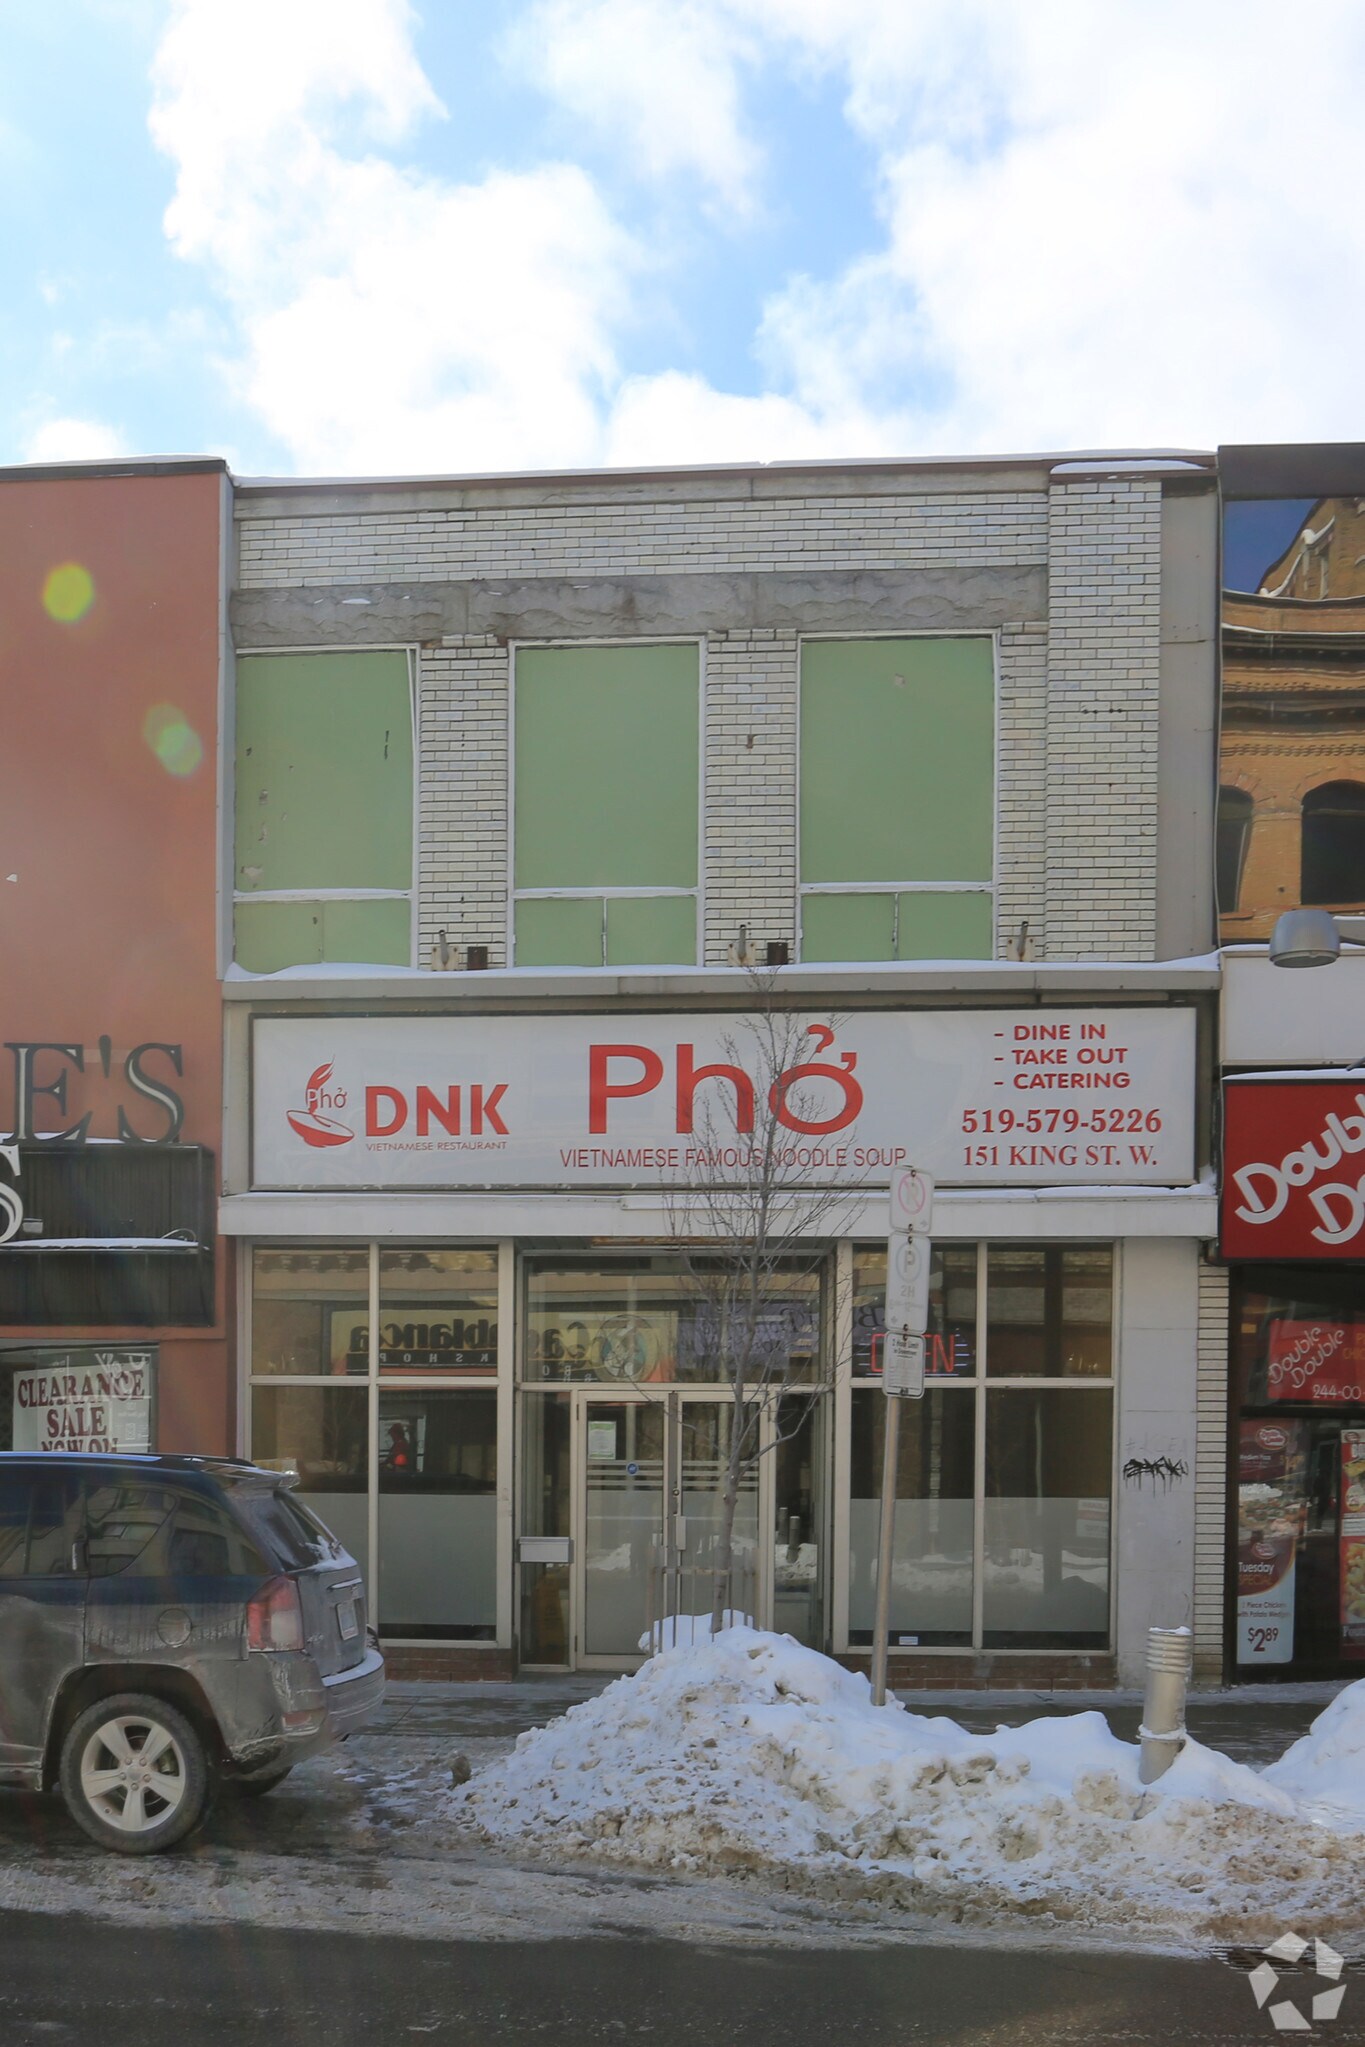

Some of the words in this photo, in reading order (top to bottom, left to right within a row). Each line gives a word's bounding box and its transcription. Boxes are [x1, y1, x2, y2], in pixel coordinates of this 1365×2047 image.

[1014, 1025, 1070, 1040] DINE
[1081, 1024, 1105, 1039] IN
[1012, 1049, 1067, 1064] TAKE
[1077, 1048, 1128, 1064] OUT
[1013, 1072, 1130, 1089] CATERING
[366, 1084, 509, 1136] DNK
[962, 1109, 1162, 1133] 519-579-5226
[366, 1142, 433, 1152] VIETNAMESE
[437, 1141, 507, 1151] RESTAURANT
[964, 1146, 998, 1165] 151
[1009, 1146, 1078, 1165] KING
[1085, 1145, 1120, 1165] ST.
[1129, 1146, 1157, 1165] W.
[560, 1149, 679, 1167] VIETNAMESE
[685, 1149, 763, 1167] FAMOUS
[770, 1148, 847, 1167] NOODLE
[853, 1148, 906, 1167] SOUP
[1268, 1327, 1321, 1384] Double
[1290, 1329, 1344, 1388] Double
[18, 1369, 145, 1408] CLEARANCE
[47, 1406, 107, 1438] SALE
[1238, 1562, 1275, 1575] Tuesday
